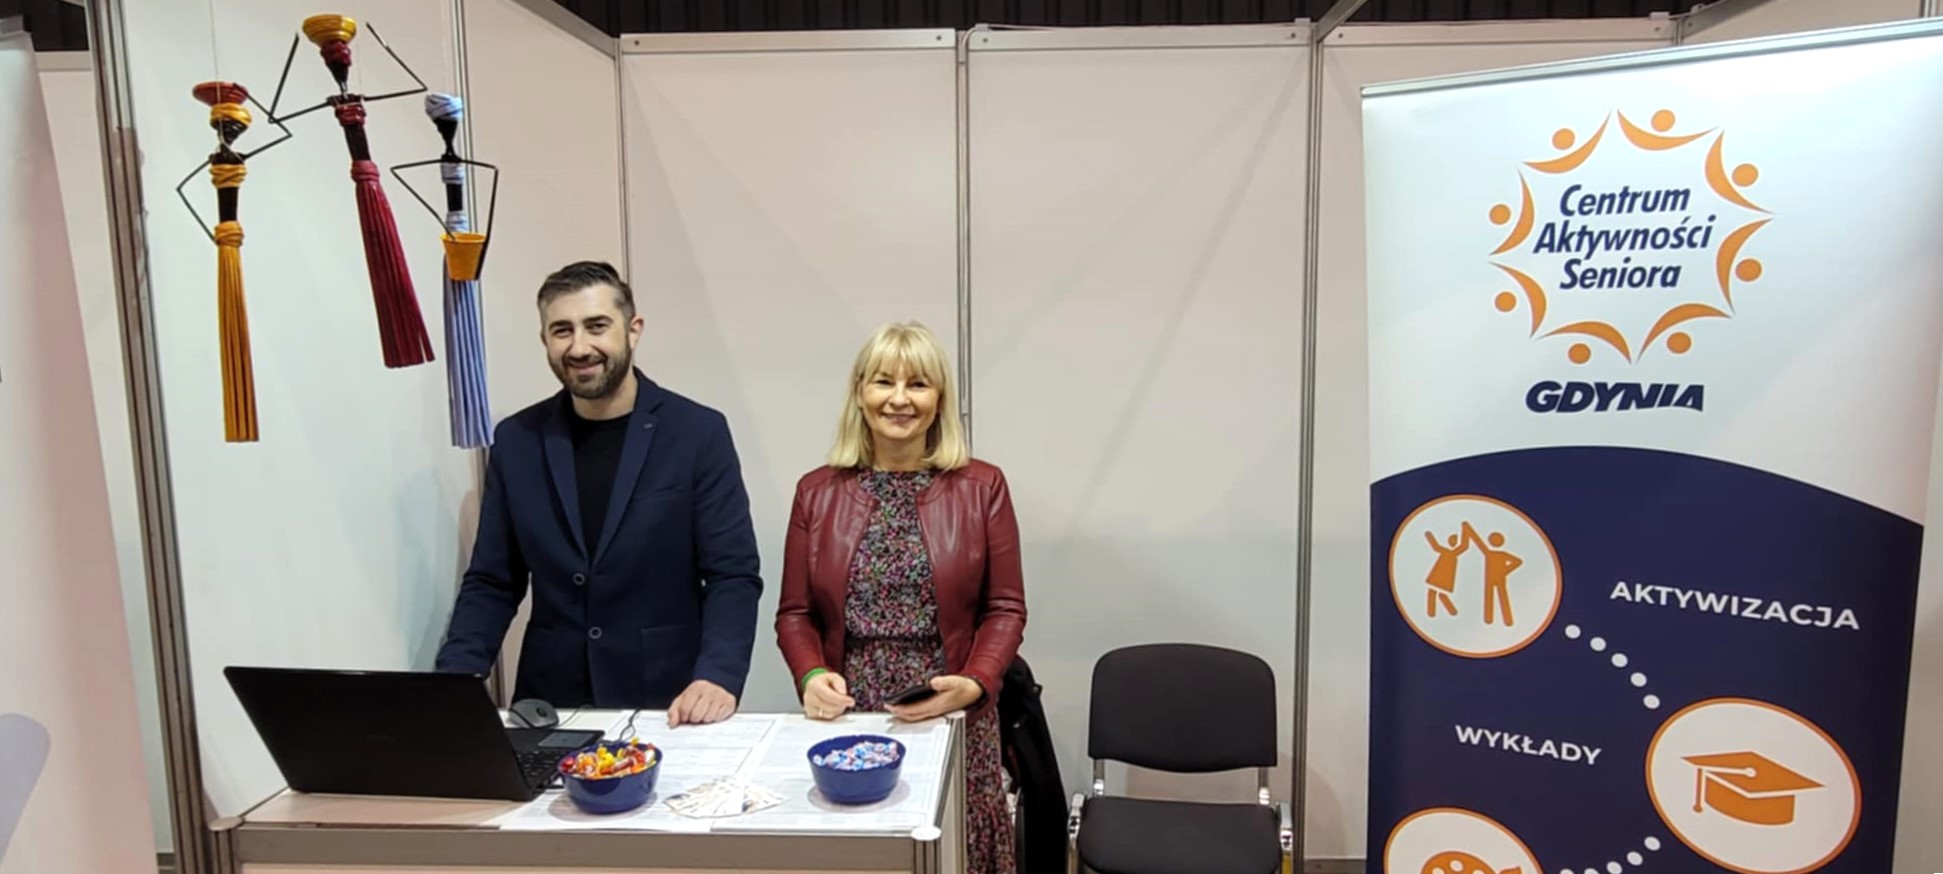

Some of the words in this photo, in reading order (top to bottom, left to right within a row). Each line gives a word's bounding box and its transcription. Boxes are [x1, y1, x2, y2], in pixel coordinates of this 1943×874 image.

[1560, 184, 1691, 217] Centrum
[1533, 215, 1716, 260] Aktywności
[1559, 257, 1682, 290] Seniora
[1525, 380, 1705, 413] GDYNIA
[1610, 581, 1860, 631] AKTYWIZACJA
[1455, 724, 1602, 765] WYKŁADY
